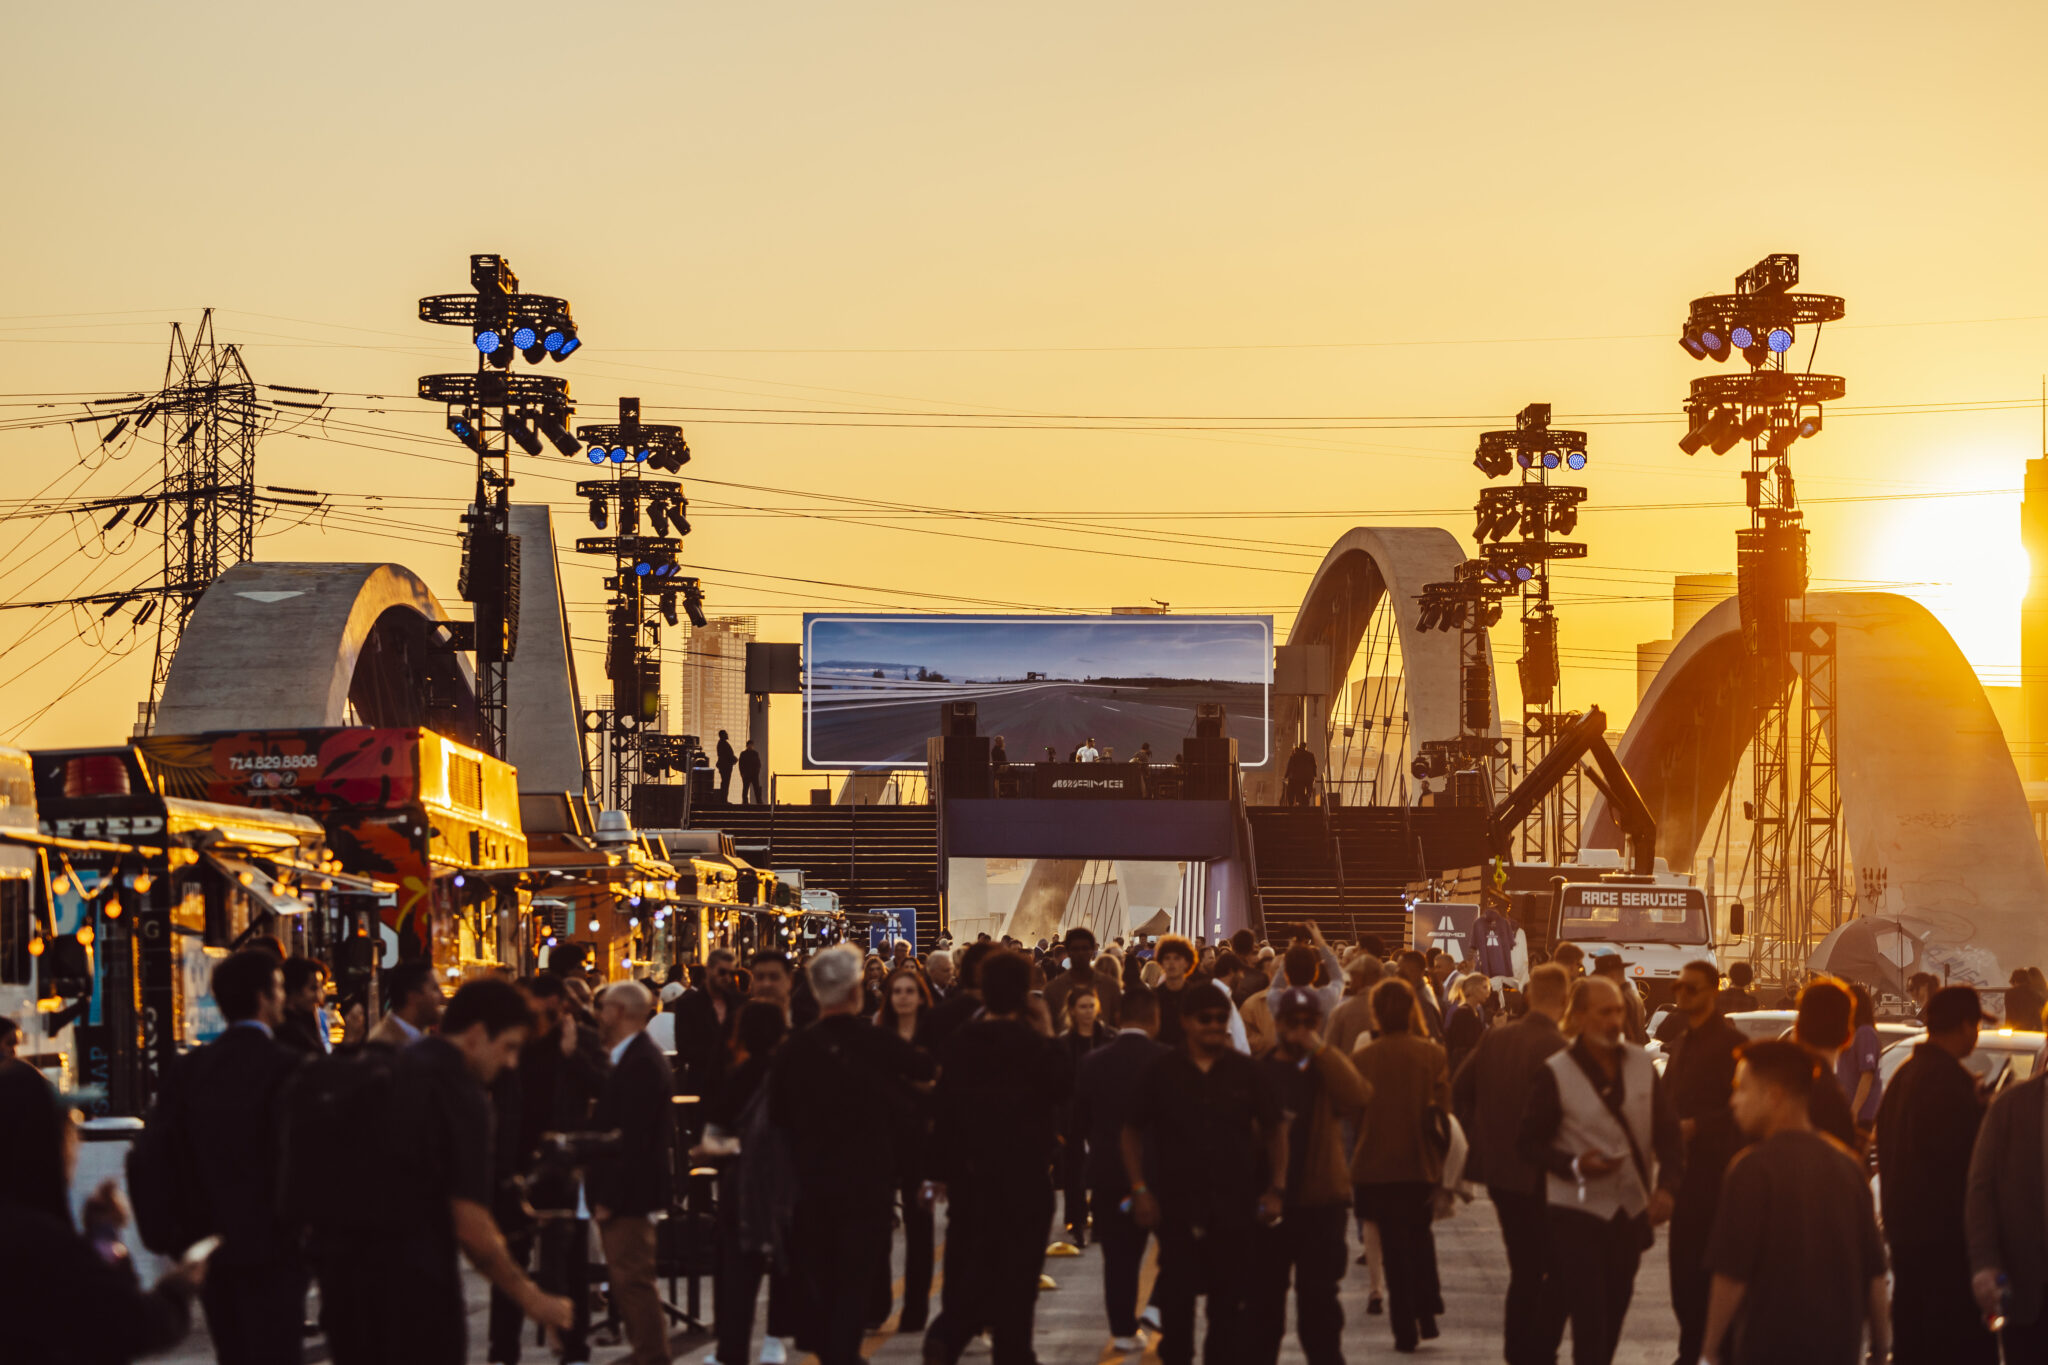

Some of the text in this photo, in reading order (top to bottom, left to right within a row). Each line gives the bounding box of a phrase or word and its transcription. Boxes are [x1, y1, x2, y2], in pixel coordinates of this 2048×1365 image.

[229, 755, 318, 770] 714.829.8806
[1076, 779, 1124, 789] AMG
[1582, 891, 1687, 907] RACE SERVICE
